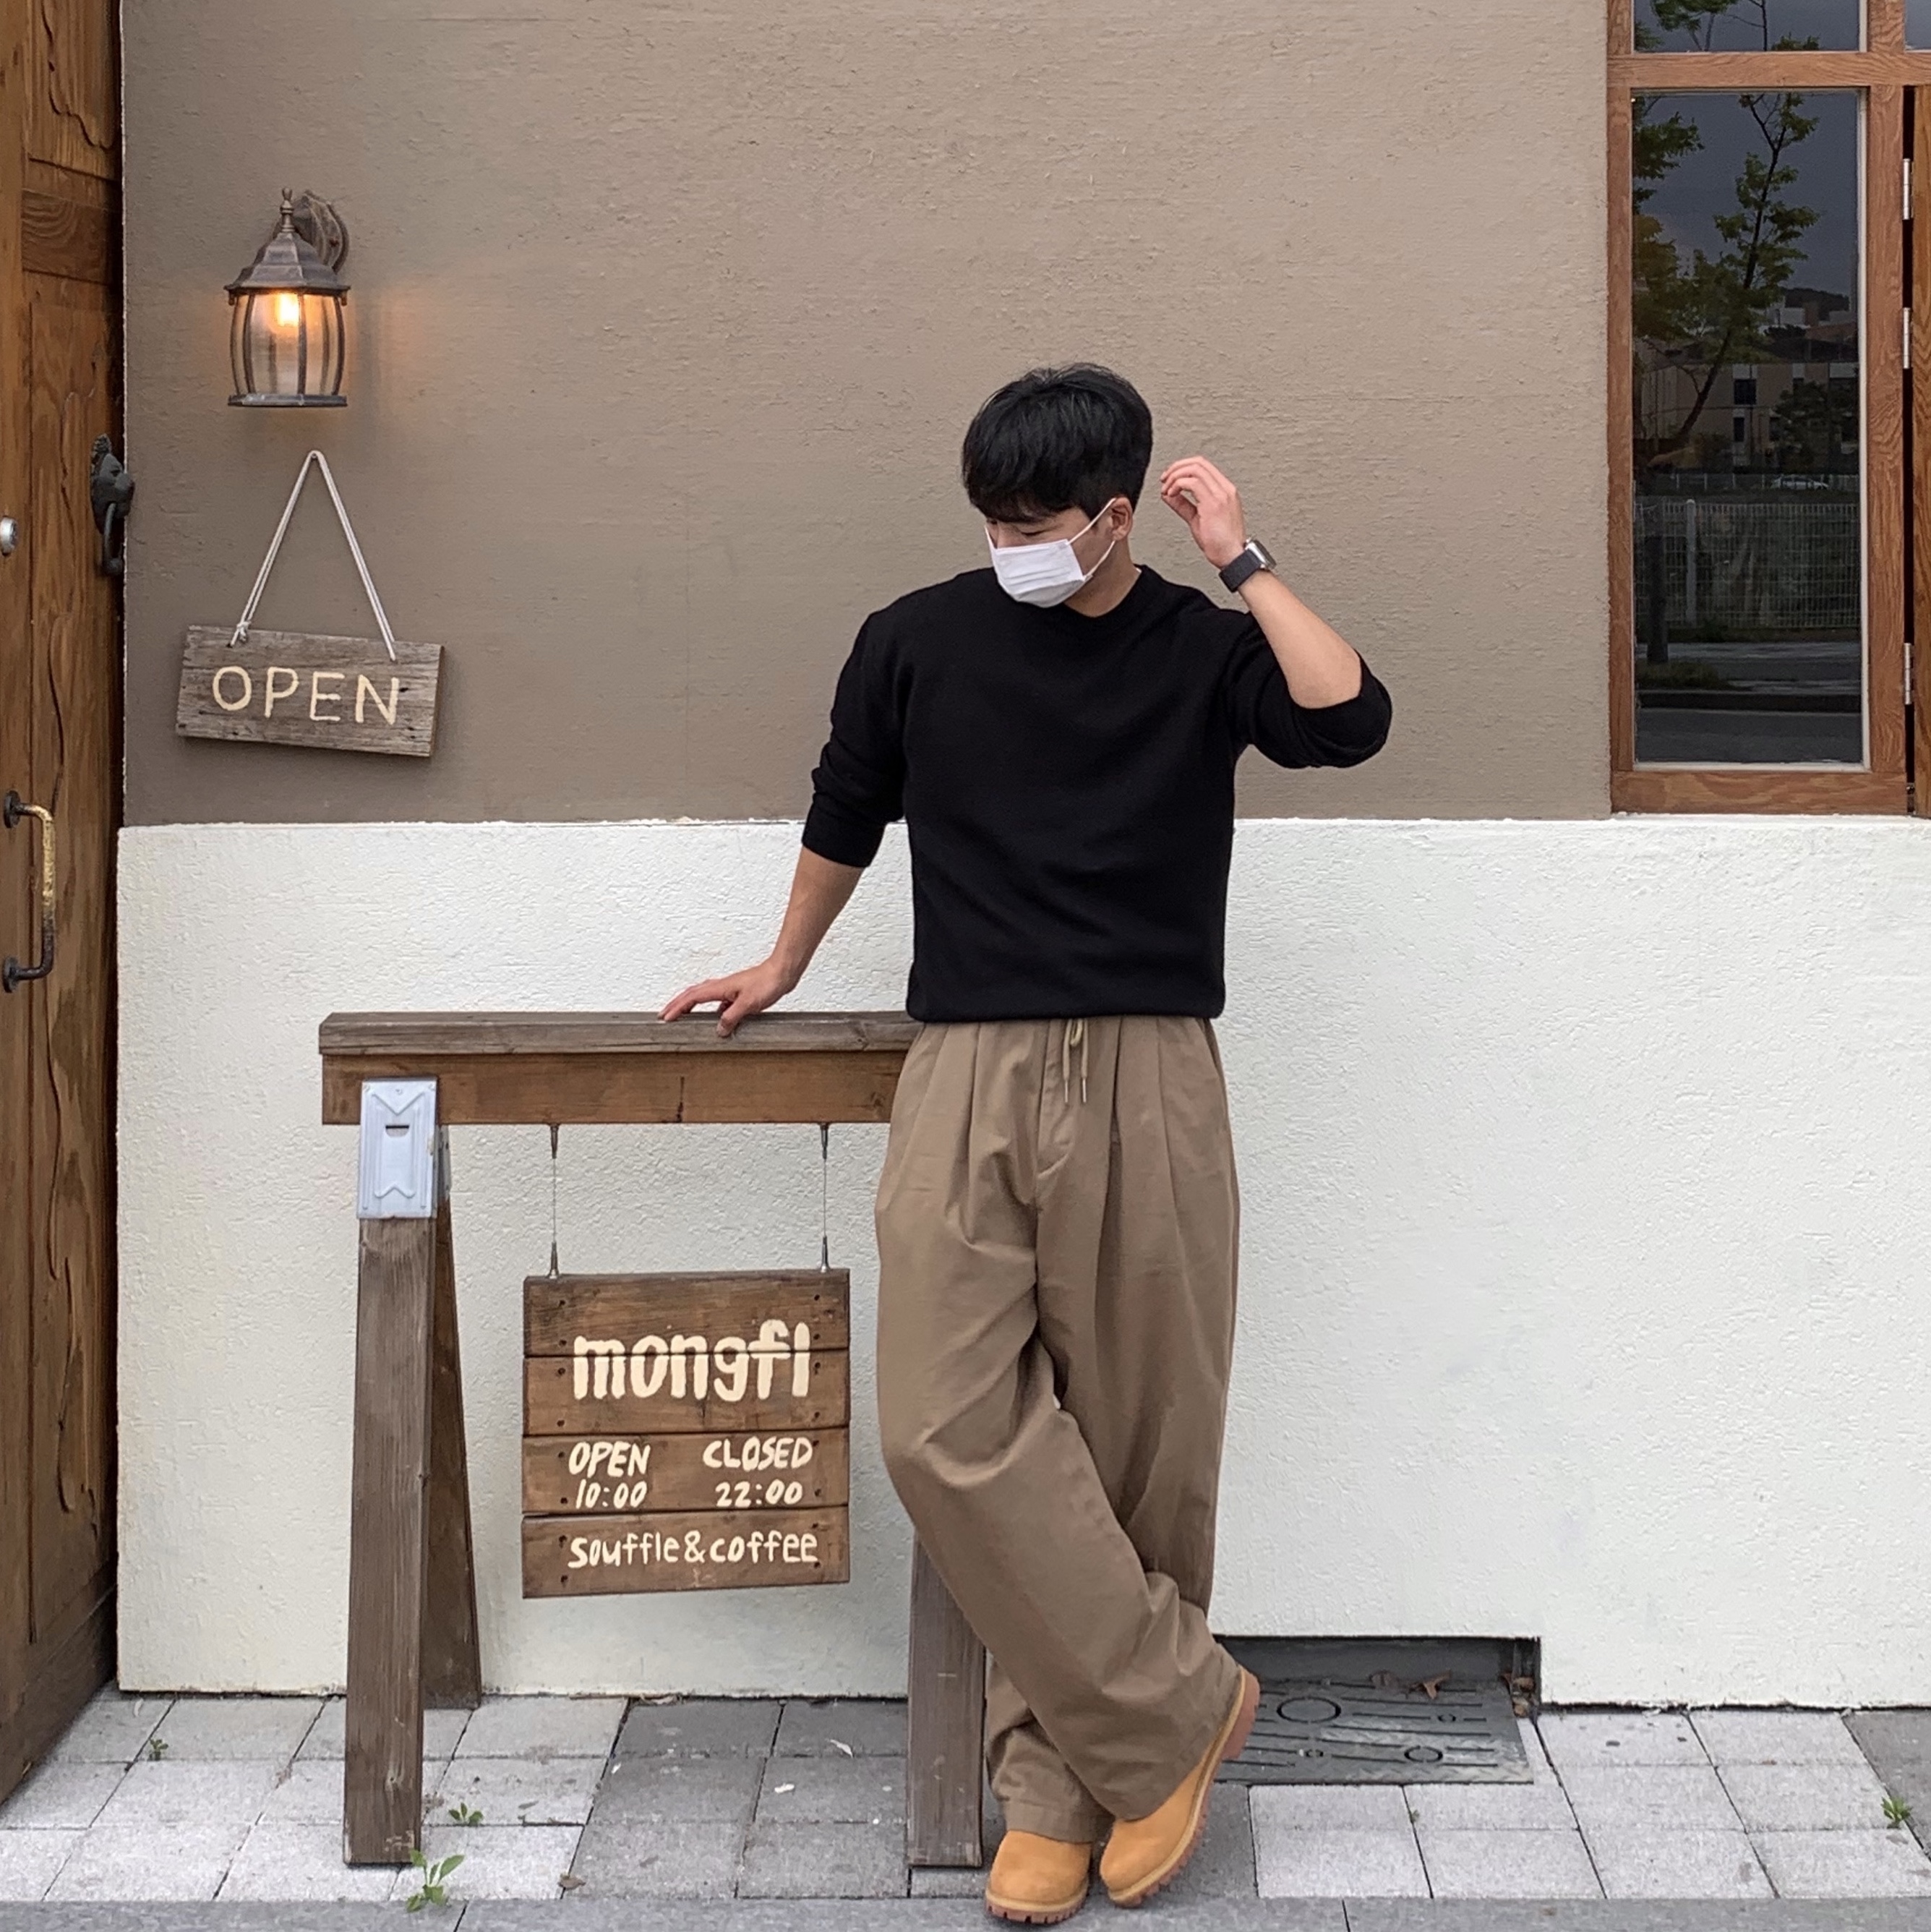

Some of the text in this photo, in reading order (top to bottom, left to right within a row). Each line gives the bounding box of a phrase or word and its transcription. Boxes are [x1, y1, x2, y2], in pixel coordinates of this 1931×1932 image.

[212, 665, 401, 725] OPEN
[568, 1441, 651, 1478] OPEN
[703, 1436, 813, 1471] CLOSED
[575, 1479, 647, 1509] 10:00
[715, 1479, 802, 1508] 22:00
